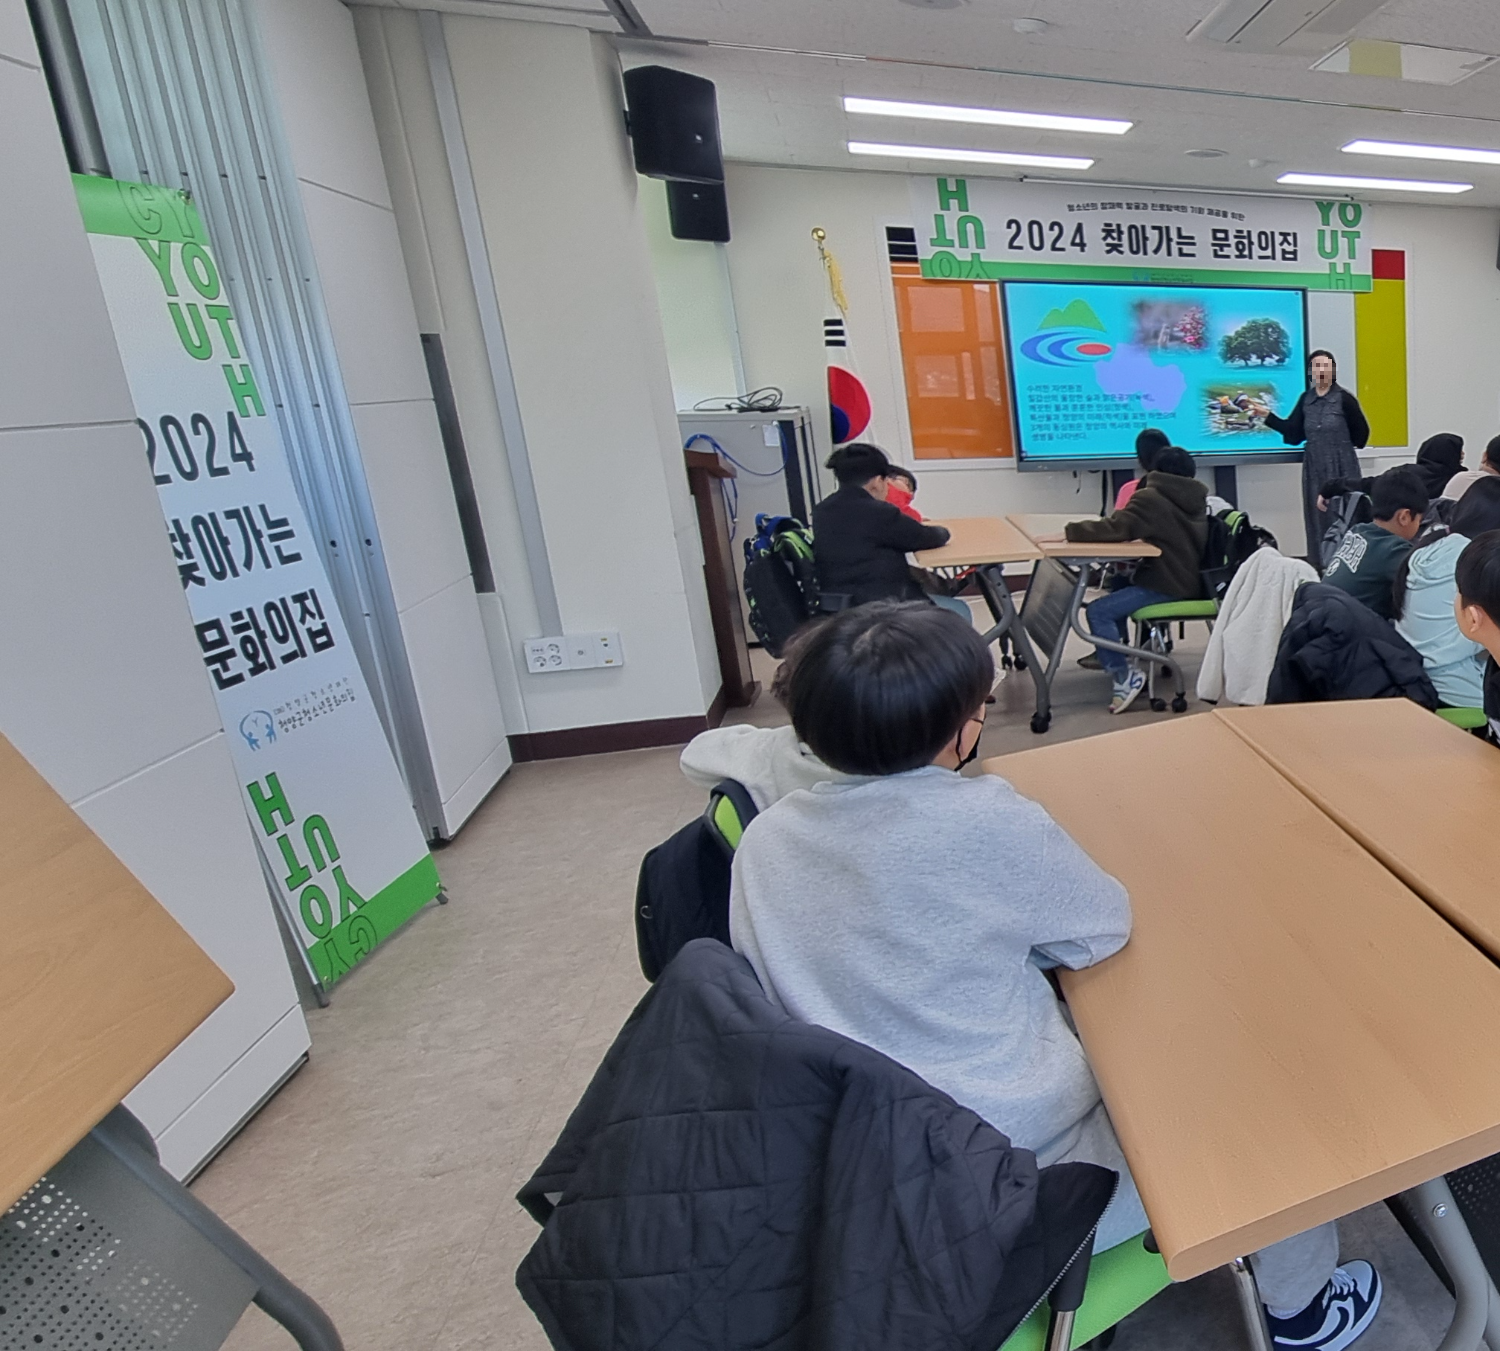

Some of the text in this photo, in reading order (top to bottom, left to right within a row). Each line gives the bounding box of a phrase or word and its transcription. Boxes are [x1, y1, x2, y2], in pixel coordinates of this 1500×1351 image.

[1006, 219, 1298, 262] 2024 찾아가는 문화의집
[137, 411, 255, 486] 2024
[168, 503, 303, 590] 찾아가는
[194, 588, 335, 691] 문화의집
